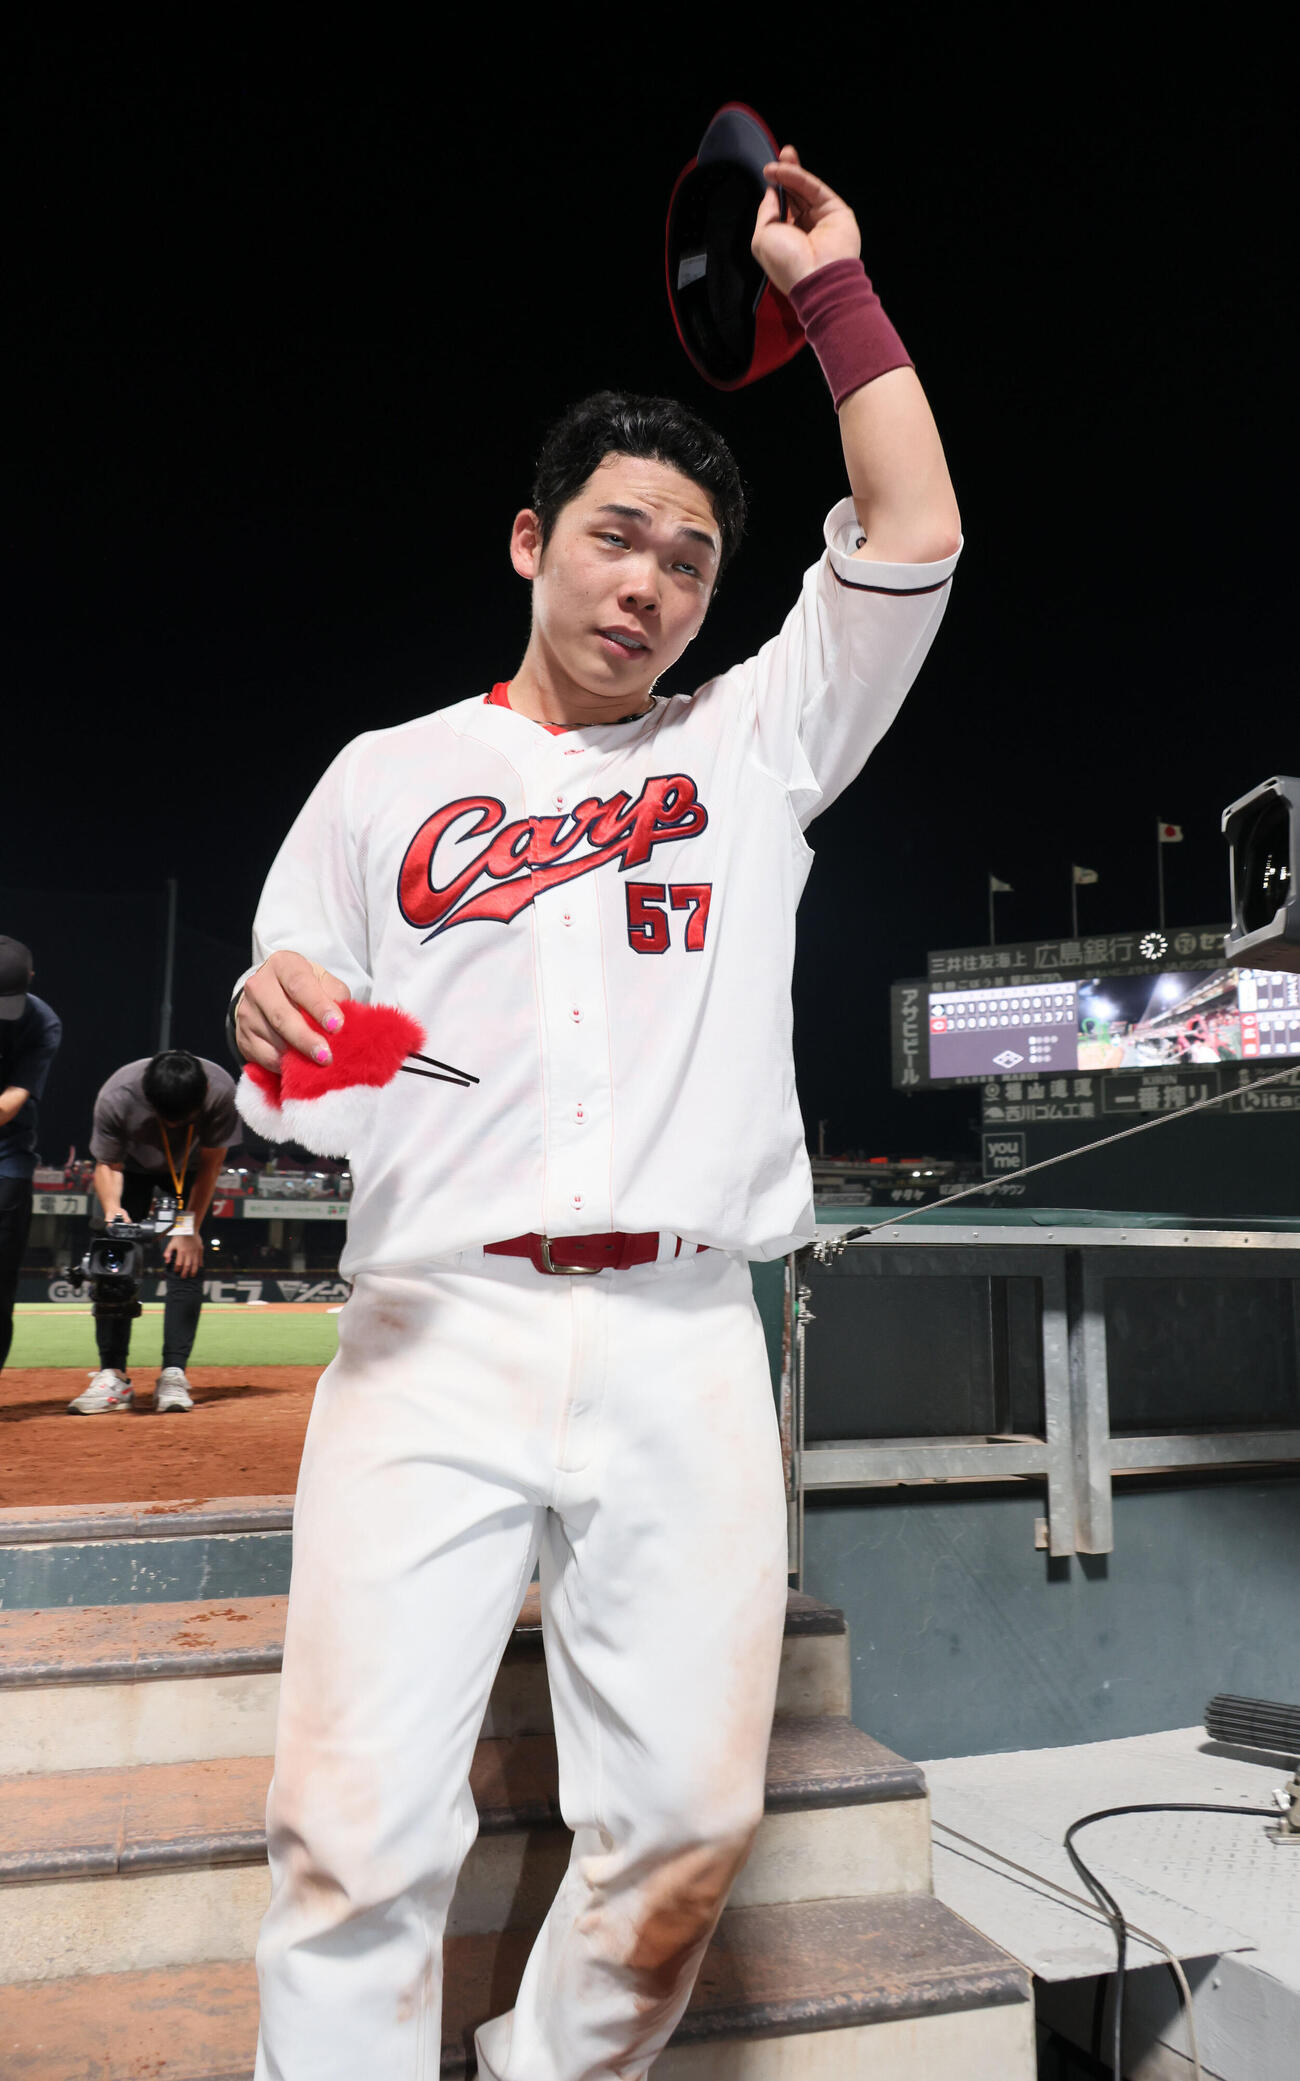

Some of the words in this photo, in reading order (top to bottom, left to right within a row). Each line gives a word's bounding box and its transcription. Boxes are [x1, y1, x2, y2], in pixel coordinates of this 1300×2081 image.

[397, 773, 709, 945] Carp
[625, 881, 713, 954] 57
[931, 951, 1027, 973] 三井住友海上
[1034, 937, 1134, 968] 広島銀行
[1055, 1011, 1063, 1022] 7
[901, 988, 920, 1085] アサヒビール
[1005, 1078, 1093, 1100] 福山通運
[1114, 1084, 1208, 1110] 一番搾り
[1005, 1102, 1095, 1122] 西川ゴム工業
[988, 1141, 1019, 1158] you
[994, 1155, 1020, 1168] me
